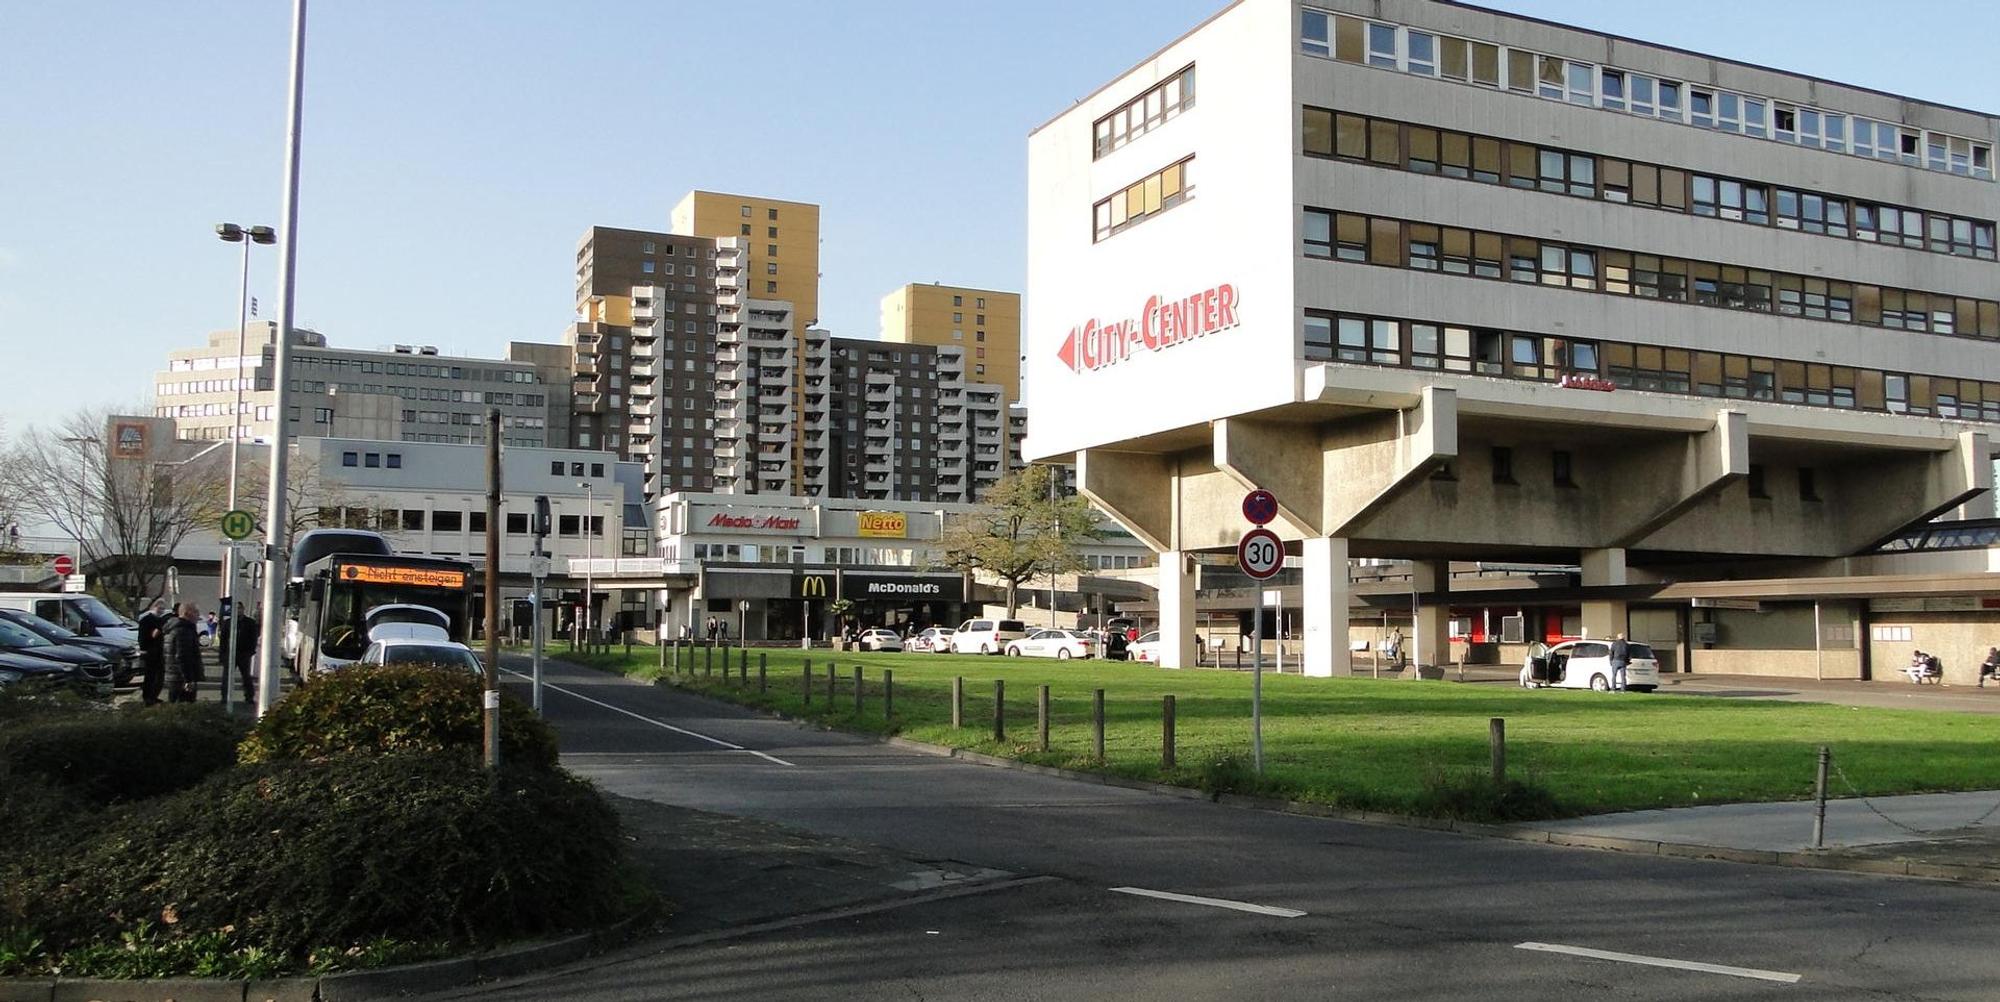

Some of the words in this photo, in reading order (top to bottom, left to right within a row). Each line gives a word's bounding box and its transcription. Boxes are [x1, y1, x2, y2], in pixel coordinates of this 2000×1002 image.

[230, 516, 246, 533] H
[861, 513, 904, 530] Netto
[1248, 542, 1274, 565] 30
[367, 566, 397, 581] Nicht
[402, 569, 457, 586] einsteigen
[868, 582, 940, 593] McDonald's
